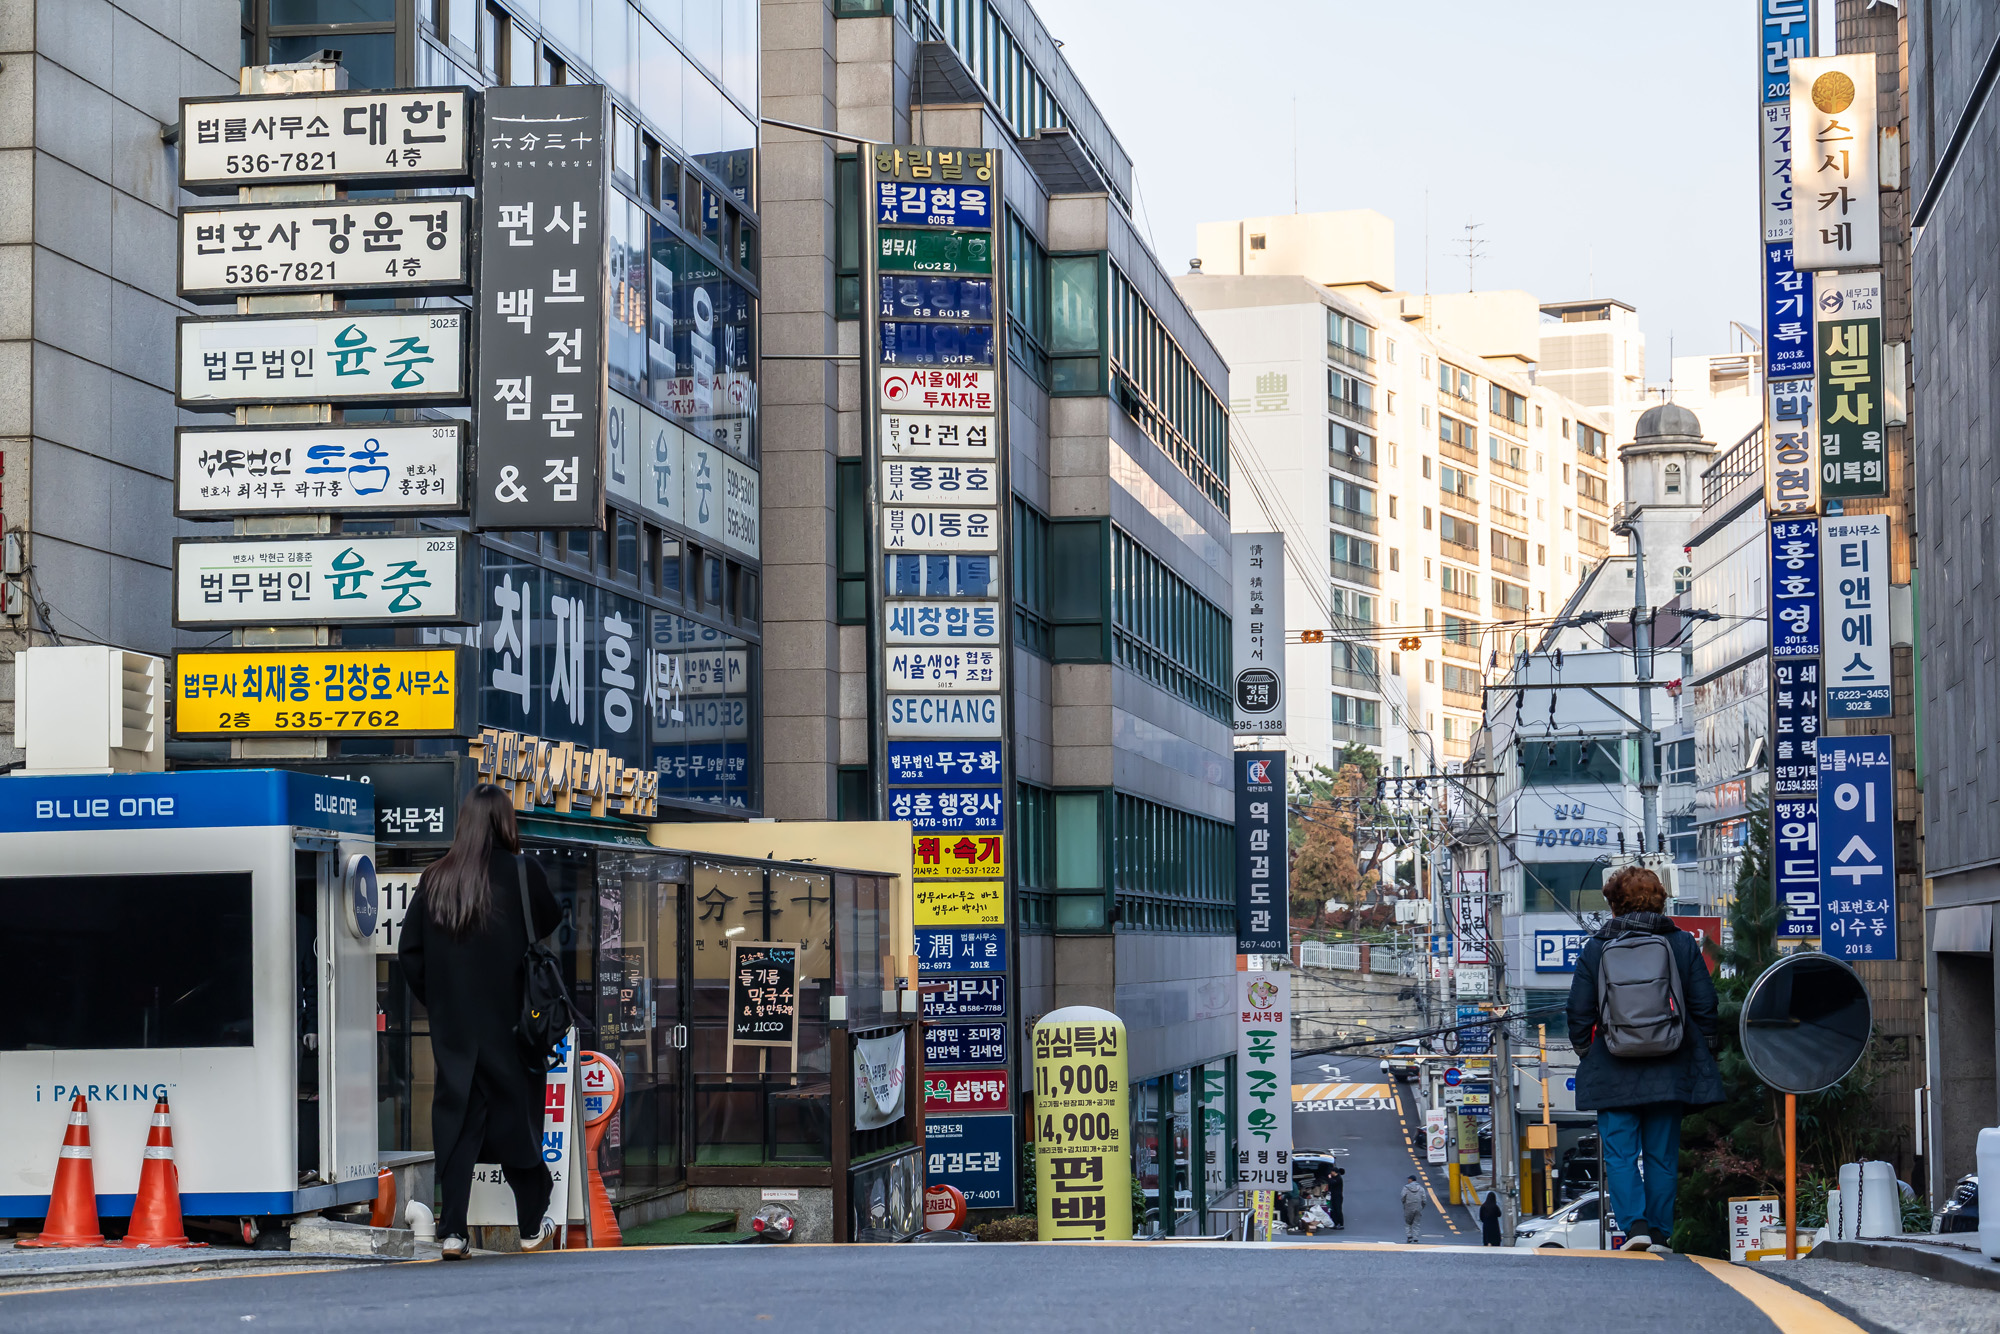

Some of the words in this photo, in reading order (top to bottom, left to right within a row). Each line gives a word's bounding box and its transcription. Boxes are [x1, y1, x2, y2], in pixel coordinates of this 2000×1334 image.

[198, 116, 330, 144] 법률사무소
[343, 101, 451, 146] 대한
[491, 131, 592, 151] 六分三十
[226, 151, 337, 173] 536-7821
[386, 148, 422, 168] 4층
[876, 149, 991, 181] 하림빌딩
[1815, 119, 1856, 252] 스시카네
[881, 183, 898, 223] 법무사
[900, 186, 986, 216] 김현옥
[928, 215, 955, 225] 605호
[197, 221, 299, 255] 변호사
[313, 210, 449, 254] 강윤경
[882, 239, 917, 256] 법무사
[225, 261, 337, 284] 536-7821
[385, 258, 421, 277] 4층
[913, 261, 957, 271] (602호)
[1846, 287, 1878, 298] 세무그룹
[1773, 270, 1808, 345] 김기록
[429, 318, 459, 330] 302호
[203, 349, 314, 381] 법무법인
[327, 324, 434, 389] 윤중
[1776, 350, 1805, 360] 203호
[1771, 361, 1812, 372] 535-3303
[1825, 324, 1873, 425] 세무사
[910, 371, 979, 389] 서울에셋
[1773, 380, 1812, 396] 변호사
[923, 392, 991, 409] 투자자문
[433, 429, 456, 438] 301호
[889, 418, 900, 453] 법무사
[908, 424, 987, 447] 안권섭
[1775, 395, 1812, 501] 박정현
[198, 448, 292, 478] 법무법인
[305, 438, 391, 496] 도움
[406, 464, 437, 476] 변호사
[1822, 460, 1881, 484] 이복희
[200, 486, 231, 497] 변호사
[237, 482, 286, 499] 최석두
[295, 480, 343, 497] 곽규홍
[398, 478, 445, 496] 홍광의
[889, 464, 904, 501] 법무사
[909, 465, 989, 491] 홍광호
[890, 510, 904, 547] 법무사
[911, 513, 989, 537] 이동윤
[1773, 522, 1818, 539] 변호사
[1828, 525, 1880, 537] 법률사무소
[426, 541, 456, 552] 202호
[232, 554, 254, 563] 변호사
[200, 571, 311, 603] 법무법인
[324, 547, 432, 614] 윤중
[1775, 540, 1815, 634] 홍호영
[1839, 539, 1875, 682] 티앤에스
[889, 607, 995, 637] 세창합동
[1251, 622, 1264, 661] 담아서
[1784, 635, 1808, 645] 301호
[492, 572, 635, 733] 최재홍
[644, 648, 684, 722] 사무소
[1774, 645, 1819, 655] 508-0635
[892, 654, 960, 680] 서울생약
[966, 651, 994, 665] 협동
[184, 673, 237, 698] 법무사
[242, 664, 391, 703] 최재홍·김창호
[396, 671, 449, 696] 사무소
[966, 668, 993, 682] 조합
[1828, 689, 1889, 701] T.6223-3453
[892, 698, 995, 724] SECHANG
[1846, 701, 1872, 711] 302호
[218, 712, 251, 729] 2층
[275, 711, 399, 727] 535-7762
[891, 755, 933, 769] 법무법인
[935, 751, 1000, 774] 무궁화
[1819, 749, 1889, 772] 법률사무소
[901, 770, 924, 779] 205호
[892, 793, 934, 816] 성훈
[938, 793, 1001, 816] 행정사
[1554, 803, 1586, 820] 신신
[381, 807, 444, 833] 전문점
[975, 817, 997, 826] 301호
[1830, 782, 1883, 886] 이수
[913, 837, 1000, 864] 취·속기
[945, 867, 1000, 875] T.02-537-1222
[1250, 802, 1271, 932] 역삼검도관
[917, 891, 975, 903] 법무사사무소
[981, 891, 999, 899] 바로
[932, 905, 959, 916] 법무사
[1827, 899, 1889, 914] 대표변호사
[1788, 924, 1814, 934] 501호
[1830, 917, 1887, 937] 이수동
[960, 933, 997, 942] 법률사무소
[962, 943, 998, 957] 서윤
[1845, 944, 1873, 954] 201호
[739, 969, 780, 986] 들기름
[748, 987, 793, 1004] 막국수
[1242, 1011, 1283, 1023] 본사직영
[925, 1029, 958, 1042] 최영민
[968, 1028, 1001, 1040] 조미경
[1035, 1027, 1117, 1059] 점심특선
[926, 1046, 959, 1059] 임만혁
[969, 1044, 1002, 1058] 김세연
[1036, 1064, 1118, 1098] 11,900원
[954, 1081, 1005, 1102] 설렁탕
[925, 1124, 962, 1133] 대한검도회
[1038, 1112, 1119, 1144] 14,900원
[1238, 1150, 1288, 1165] 설렁탕
[1238, 1169, 1288, 1184] 도가니탕
